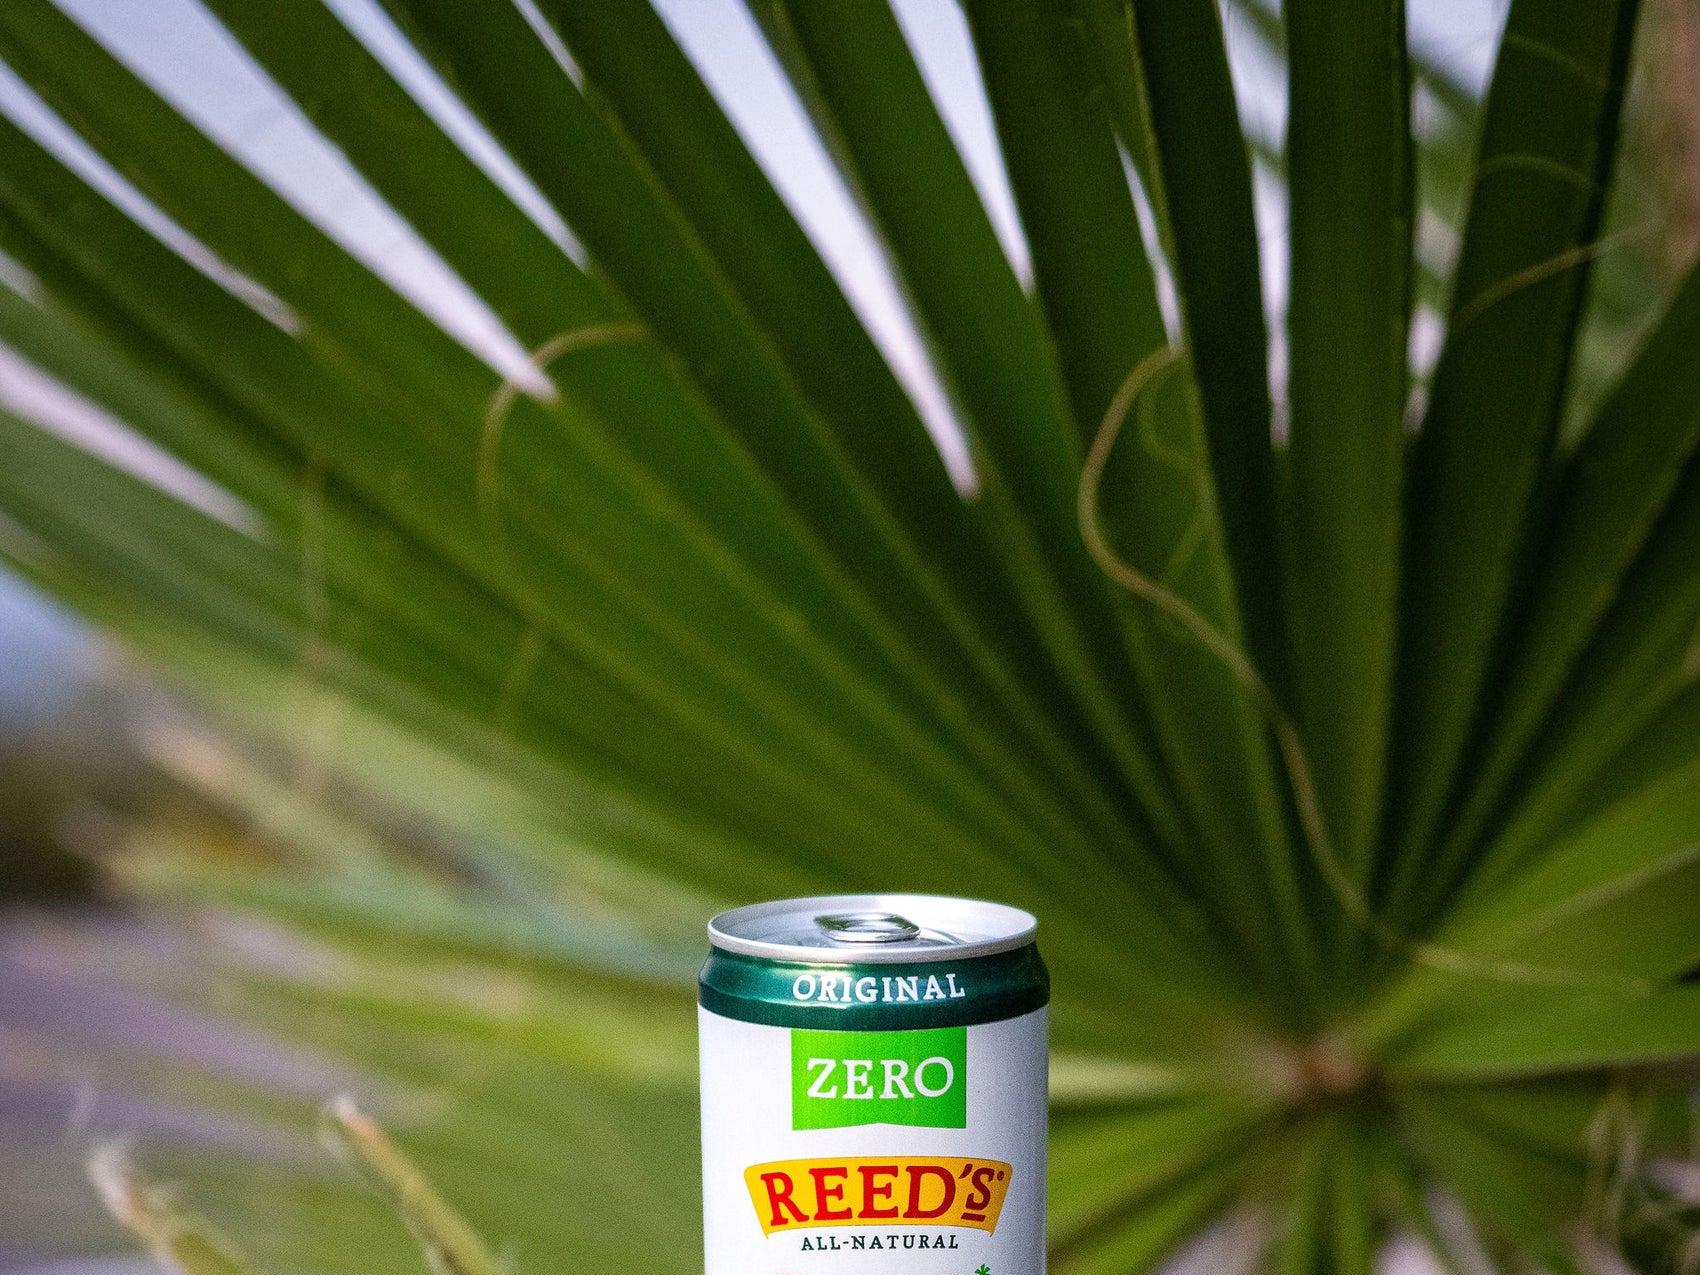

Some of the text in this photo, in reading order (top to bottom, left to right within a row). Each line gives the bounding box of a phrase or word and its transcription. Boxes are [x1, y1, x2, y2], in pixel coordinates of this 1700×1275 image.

[792, 973, 966, 1002] ORIGINAL
[806, 1056, 954, 1100] ZERO
[801, 1234, 960, 1251] ALL-NATURAL
